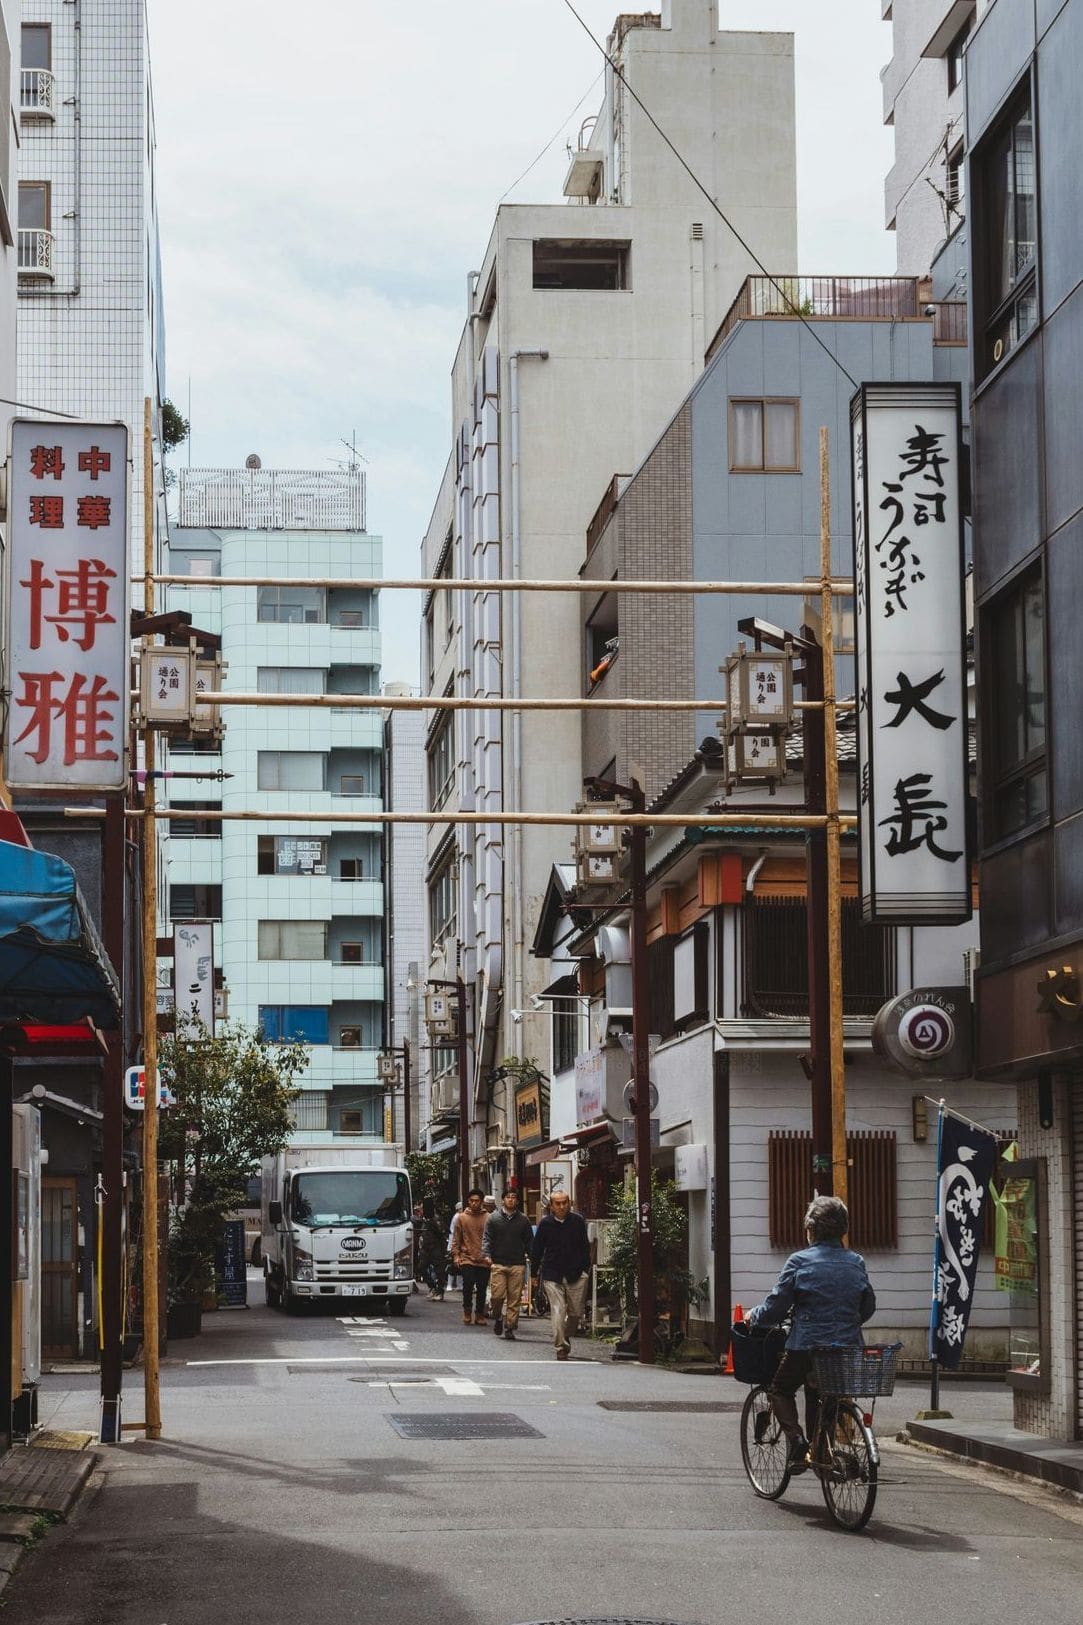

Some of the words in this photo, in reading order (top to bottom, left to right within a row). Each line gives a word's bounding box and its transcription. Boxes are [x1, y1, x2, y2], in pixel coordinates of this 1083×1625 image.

[29, 446, 66, 530] 料理
[77, 446, 111, 530] 中華
[898, 424, 950, 526] 寿司
[875, 482, 926, 618] うなぎ
[12, 558, 120, 766] 博雅
[169, 666, 180, 688] 公園
[766, 672, 777, 693] 公園
